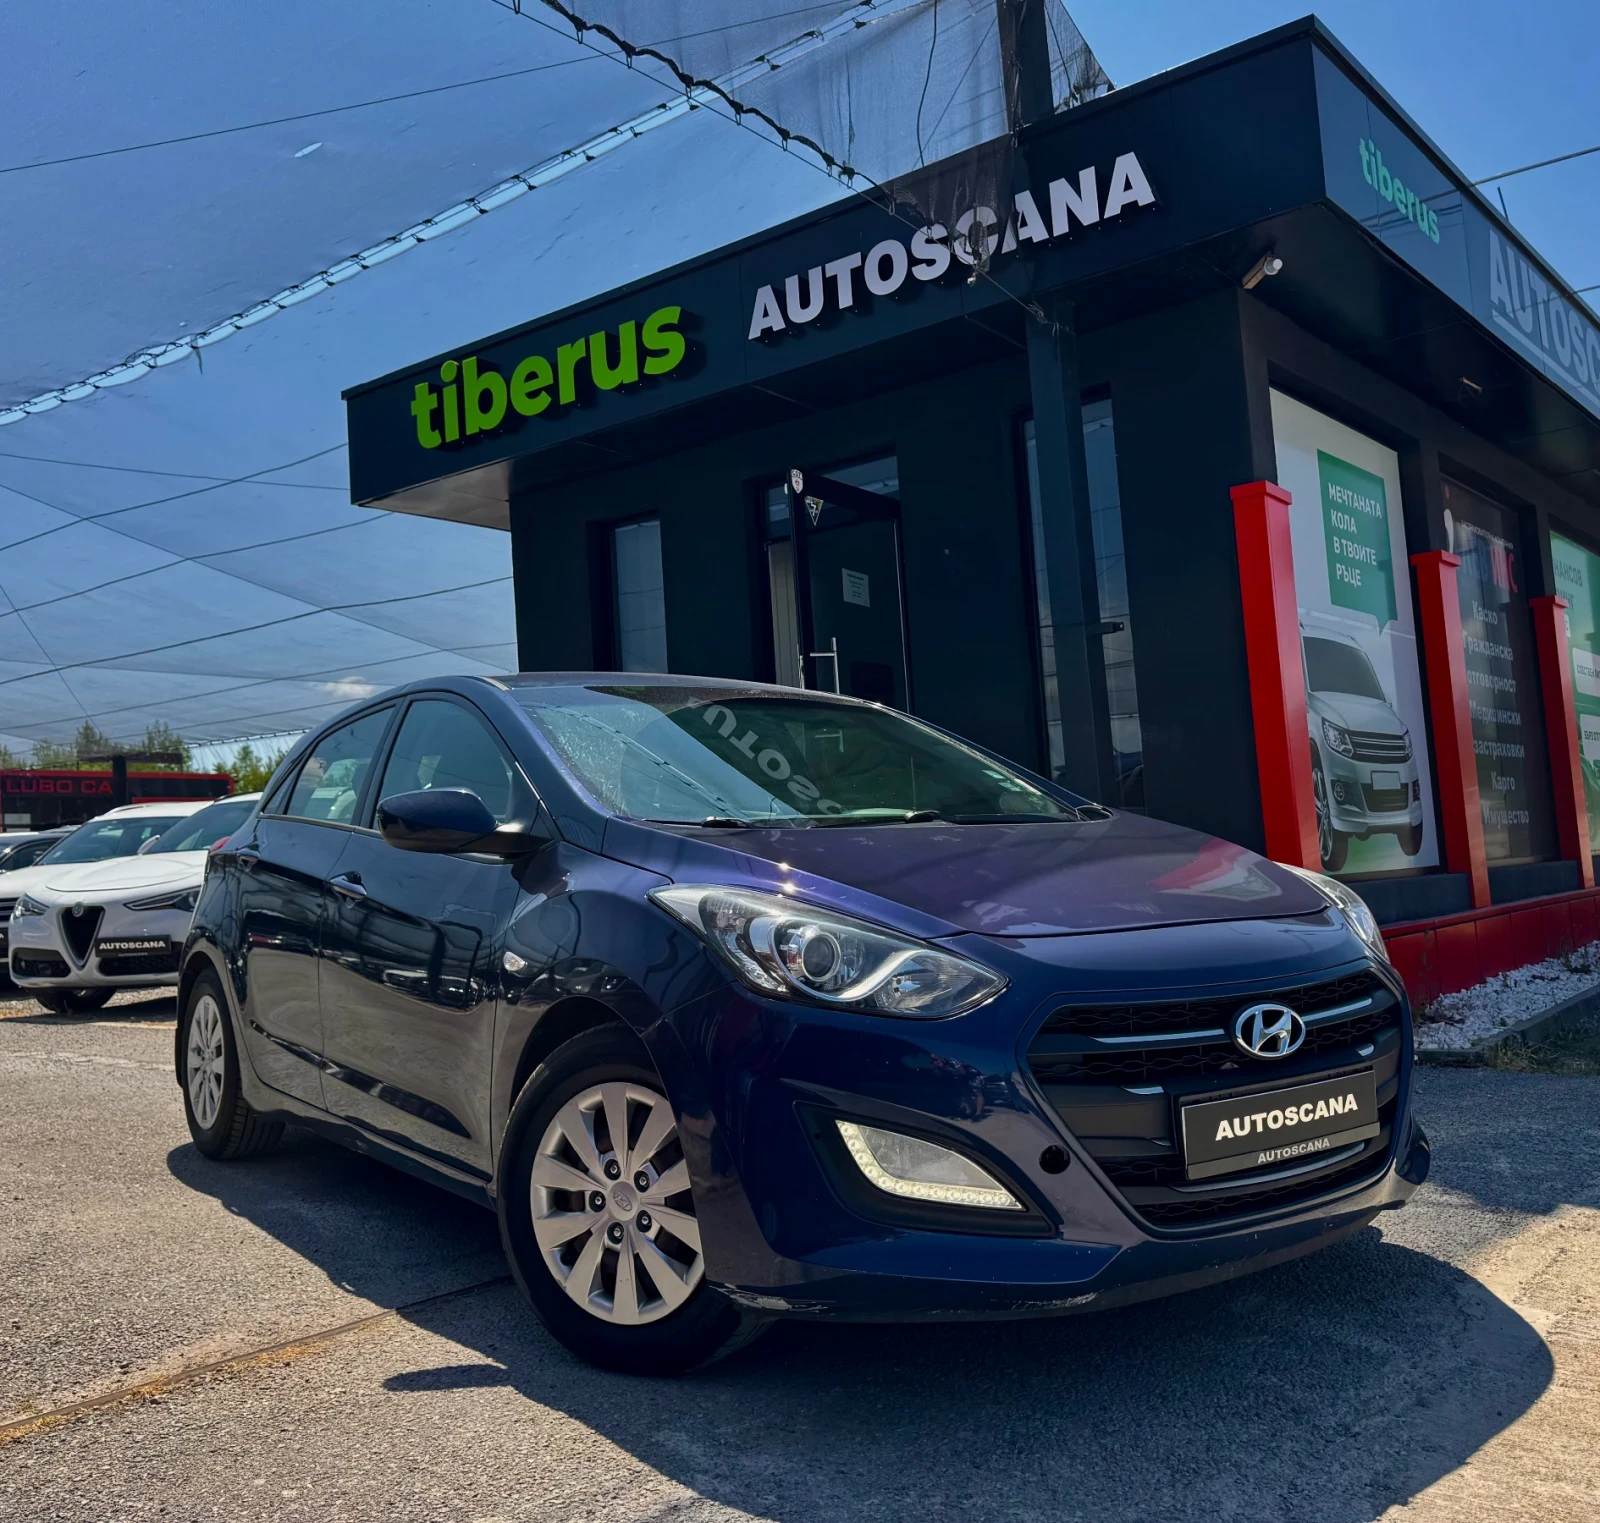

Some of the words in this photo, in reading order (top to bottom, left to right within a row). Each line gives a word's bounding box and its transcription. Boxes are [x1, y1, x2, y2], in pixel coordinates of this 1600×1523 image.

[1359, 137, 1440, 244] tiberus
[748, 151, 1156, 340] AUTOSCANA
[411, 306, 686, 449] tiberus
[1328, 482, 1382, 519] МЕЧТАНАТА
[1331, 509, 1357, 534] КОЛА
[1333, 536, 1340, 554] В
[1341, 539, 1377, 566] ТВОИТЕ
[1336, 563, 1362, 587] РЪЦЕ
[1472, 600, 1498, 625] Каско
[1462, 630, 1513, 661] Гражданска
[1469, 700, 1521, 726] Медицински
[1473, 740, 1525, 760] застраховки
[6, 780, 73, 794] LUBO
[1491, 771, 1516, 794] Карго
[1482, 803, 1529, 830] Имущество
[99, 940, 166, 950] AUTOSCANA
[1215, 1093, 1359, 1142] AUTOSCANA
[1257, 1138, 1331, 1165] AUTOSCANA
